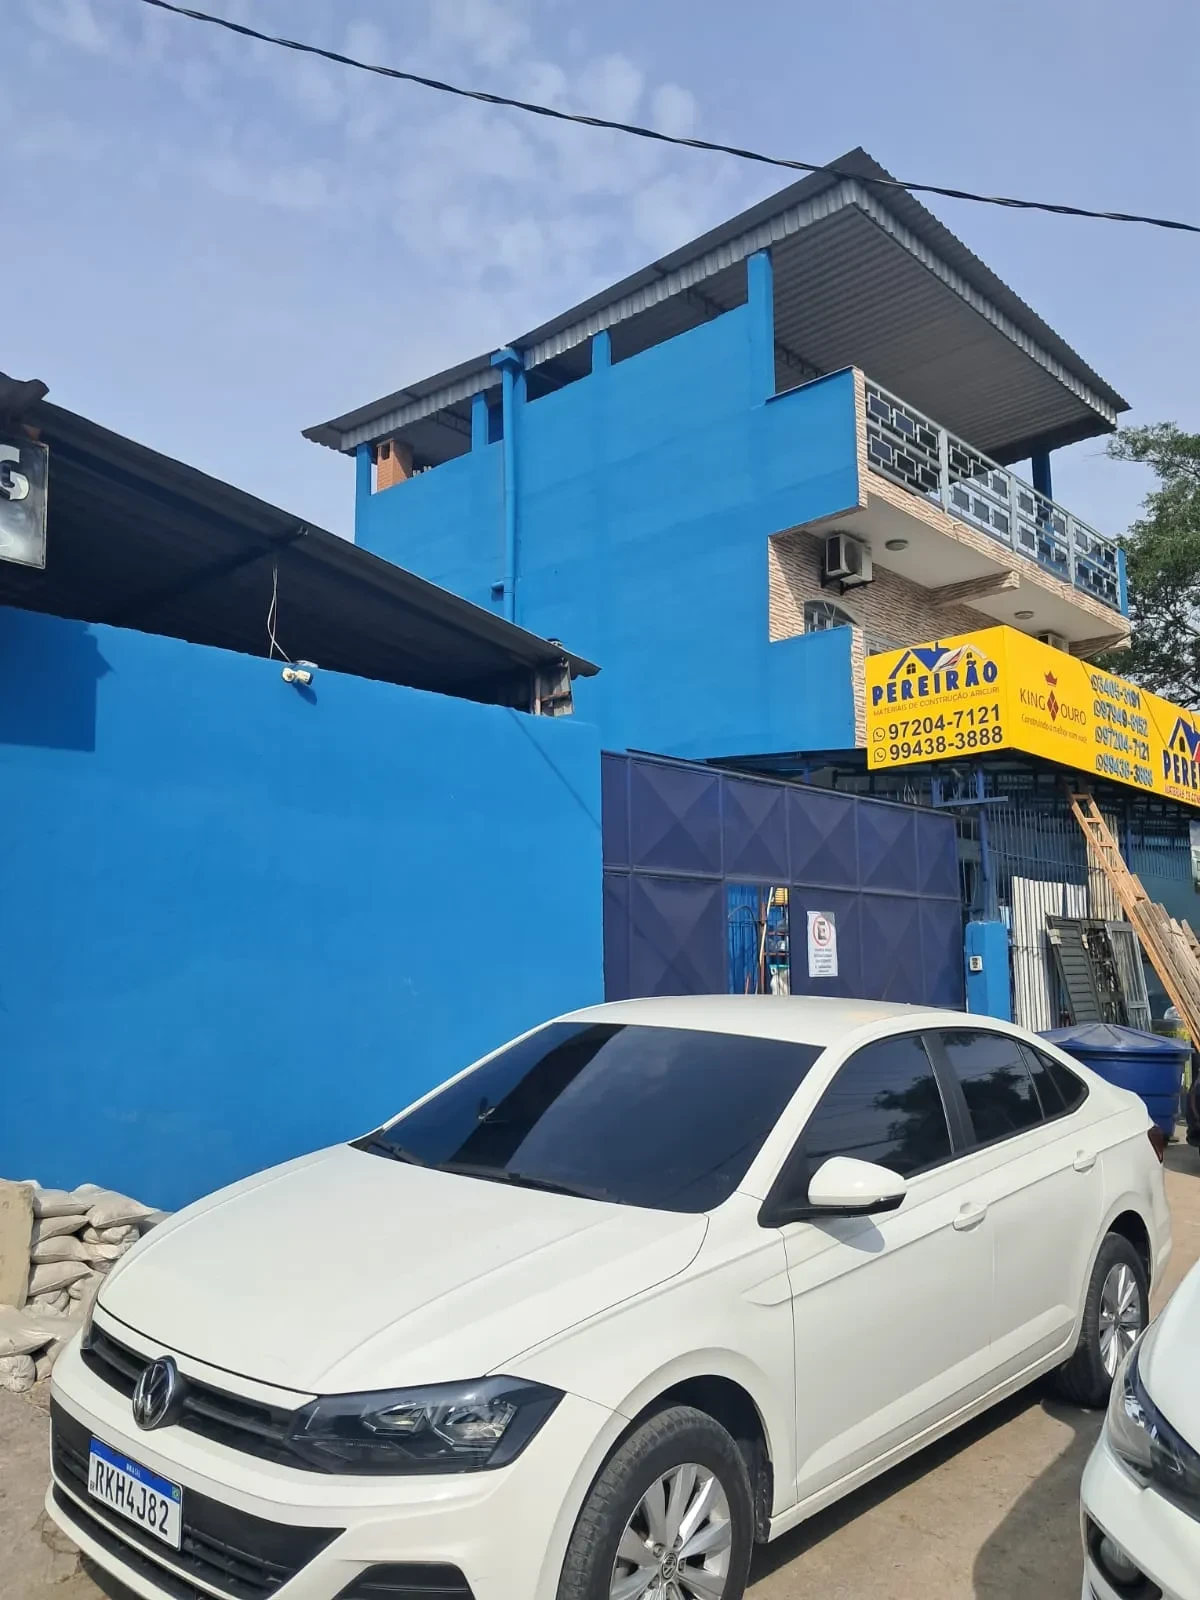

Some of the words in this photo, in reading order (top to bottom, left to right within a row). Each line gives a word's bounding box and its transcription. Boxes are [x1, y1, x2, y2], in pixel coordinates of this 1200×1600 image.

[872, 660, 998, 706] PEREIRÃO
[873, 702, 907, 717] MATERIAIS
[908, 701, 918, 710] DE
[919, 690, 969, 707] CONSTRUÇÃO
[889, 703, 1000, 740] 97204-7121
[1020, 688, 1046, 711] KING
[1060, 703, 1087, 726] OURO
[889, 725, 1003, 761] 99438-3888
[1163, 749, 1200, 790] PERE
[95, 1460, 169, 1536] RKH4J82
